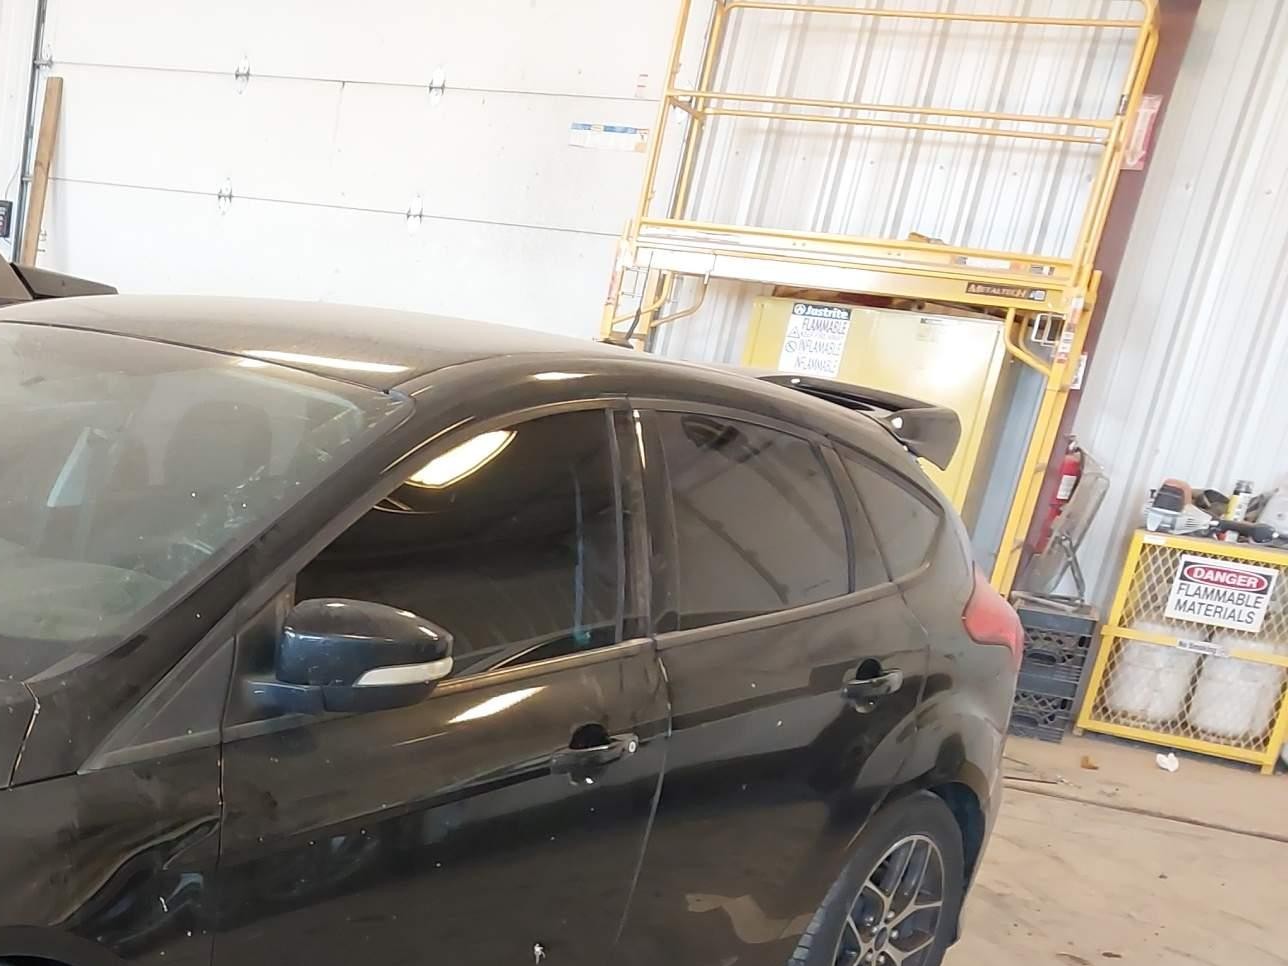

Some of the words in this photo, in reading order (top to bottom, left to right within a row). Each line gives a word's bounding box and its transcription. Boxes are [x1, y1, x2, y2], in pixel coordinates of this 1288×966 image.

[802, 318, 847, 335] FLAMMABLE
[1192, 567, 1259, 588] DANGER
[1176, 583, 1264, 609] FLAMMABLE
[1174, 598, 1256, 624] MATERIALS
